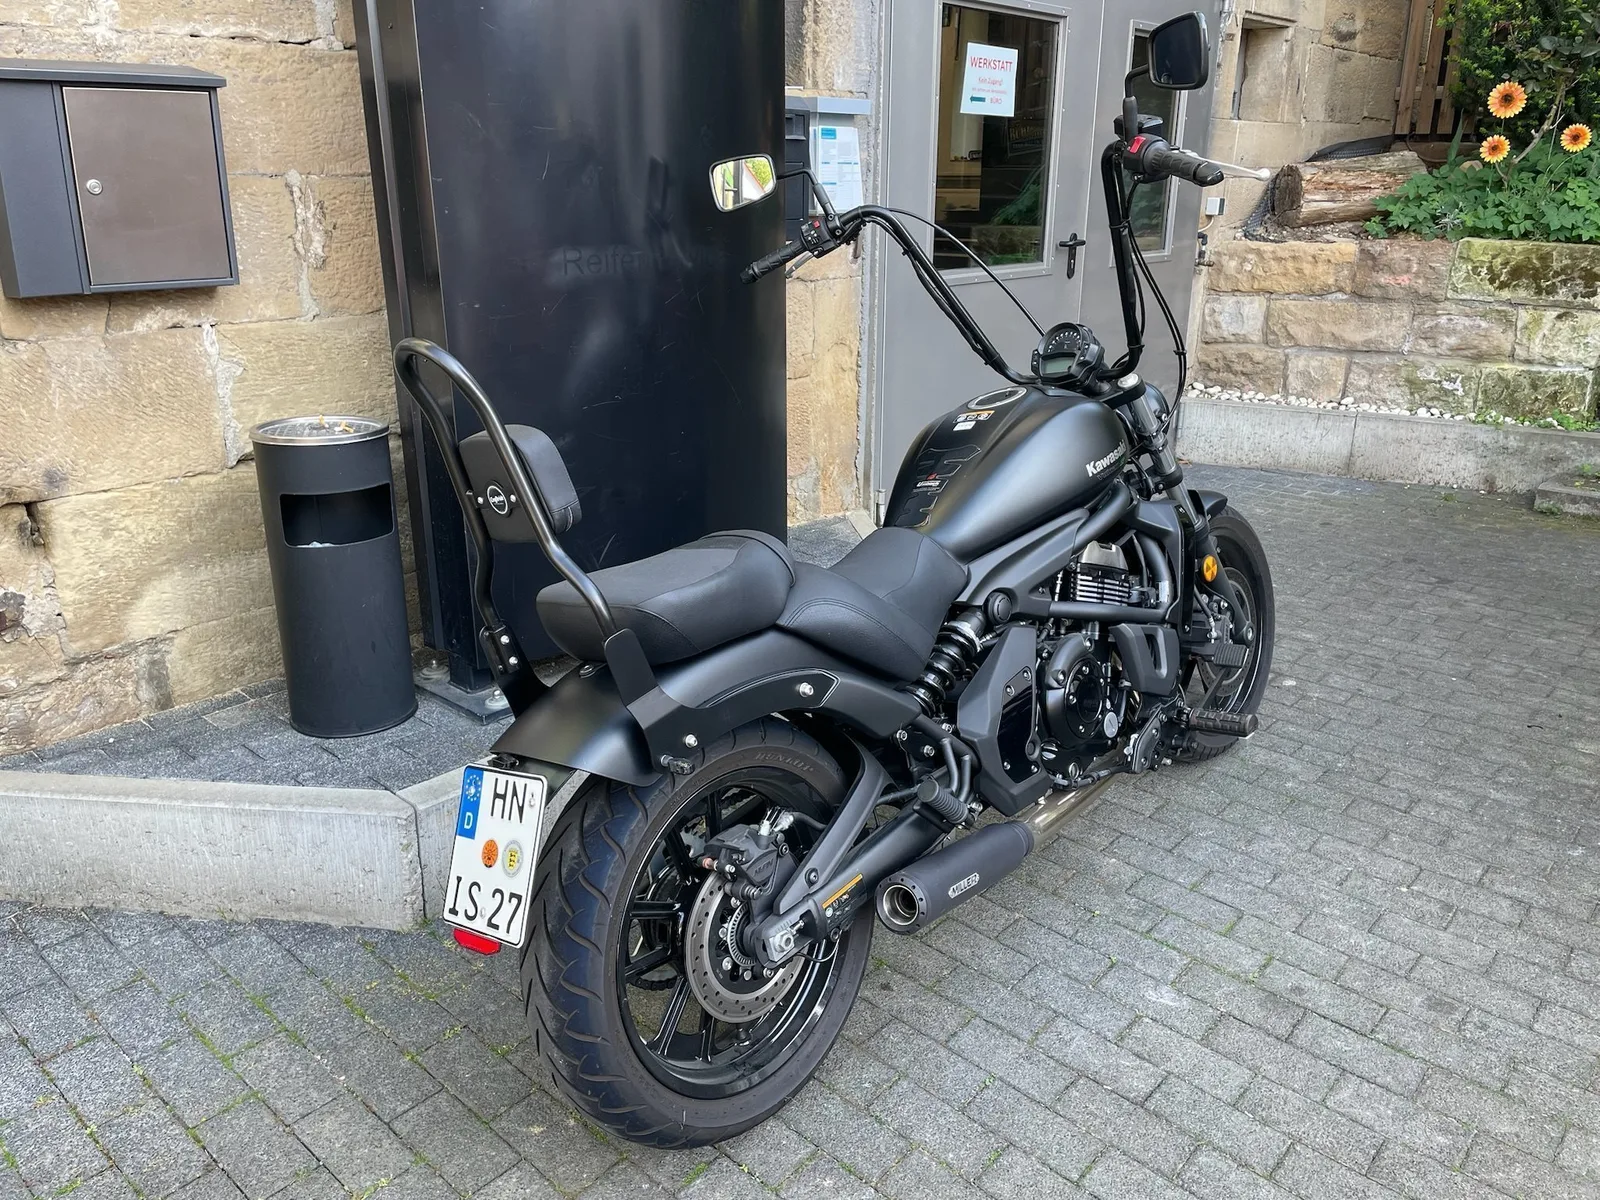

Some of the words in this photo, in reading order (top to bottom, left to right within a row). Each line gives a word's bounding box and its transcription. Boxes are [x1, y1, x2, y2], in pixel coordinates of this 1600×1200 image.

[970, 56, 1013, 72] WERKSTATT
[1085, 439, 1127, 477] Kawasaki
[490, 777, 527, 823] HN
[463, 811, 473, 830] D
[950, 874, 978, 897] MILLER
[448, 875, 482, 921] IS
[487, 888, 523, 934] 27
